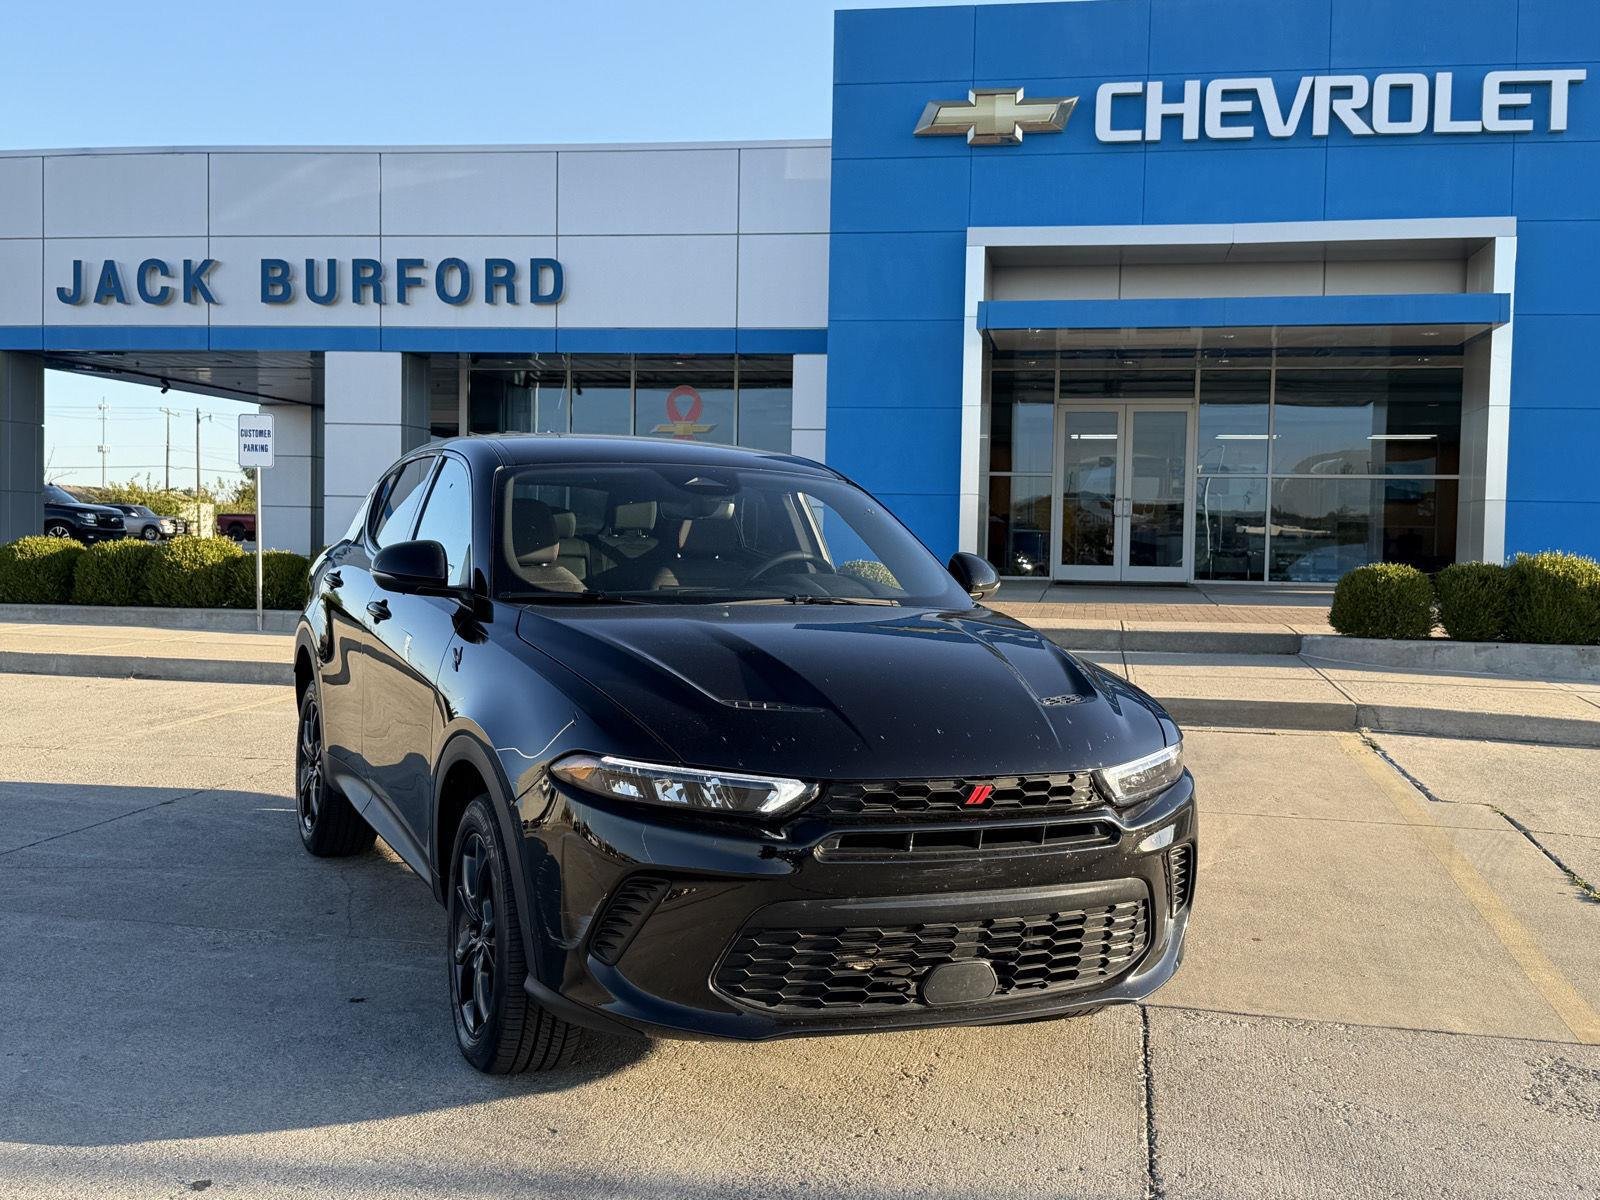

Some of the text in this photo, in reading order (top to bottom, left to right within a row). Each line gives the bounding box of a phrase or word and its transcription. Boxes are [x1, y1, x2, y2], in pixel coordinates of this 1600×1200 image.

[1095, 69, 1587, 142] CHEVROLET
[56, 257, 565, 305] JACK BURFORD
[240, 428, 272, 438] CUSTOMER
[243, 443, 269, 453] PARKING
